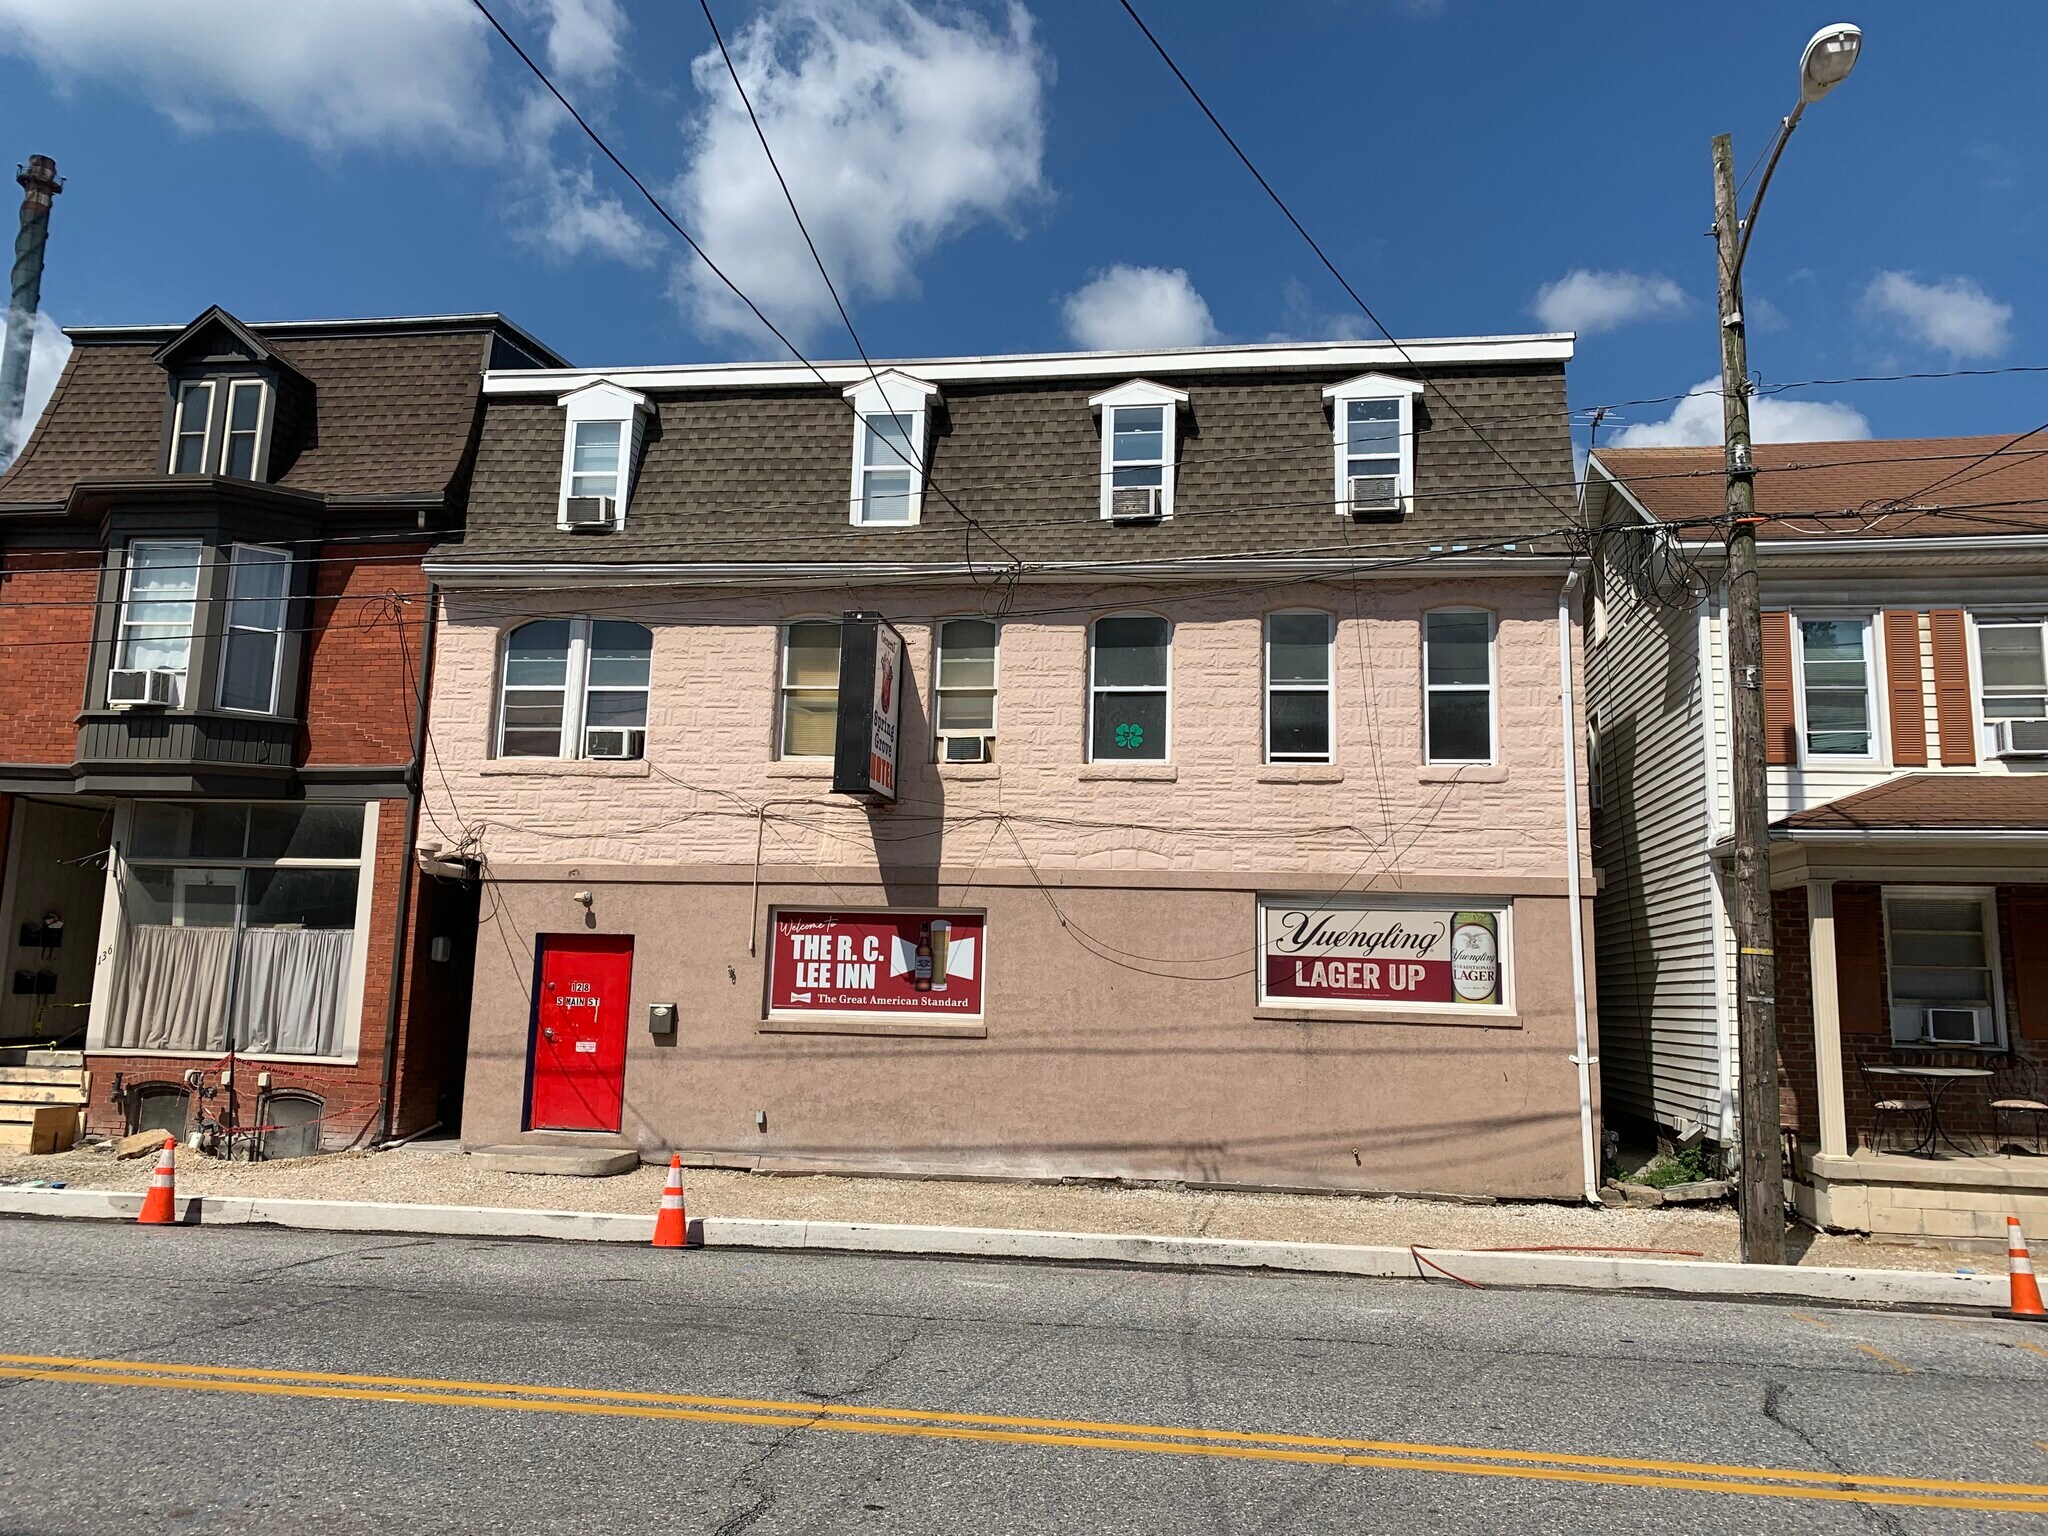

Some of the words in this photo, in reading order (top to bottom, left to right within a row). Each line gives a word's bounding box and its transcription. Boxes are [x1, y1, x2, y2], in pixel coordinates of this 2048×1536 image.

[874, 709, 896, 743] Spring
[874, 732, 892, 758] Grove
[870, 752, 894, 791] HOTEL
[780, 918, 825, 936] Welcome
[824, 915, 839, 933] to
[1276, 911, 1446, 959] Yuengling
[98, 943, 113, 966] 136
[791, 934, 832, 960] THE
[837, 935, 858, 961] R.
[863, 935, 885, 962] C.
[1452, 947, 1496, 963] Yuengling
[795, 962, 832, 989] LEE
[836, 963, 876, 989] INN
[1295, 960, 1381, 989] LAGER
[1388, 964, 1426, 991] UP
[1453, 969, 1495, 982] LAGER
[571, 983, 590, 992] 128
[557, 997, 563, 1006] S
[566, 997, 585, 1006] MAIN
[588, 998, 599, 1006] ST
[817, 994, 837, 1004] The
[839, 995, 868, 1004] Great
[870, 995, 918, 1006] American
[921, 997, 968, 1007] Standard
[261, 1065, 295, 1077] DANGER
